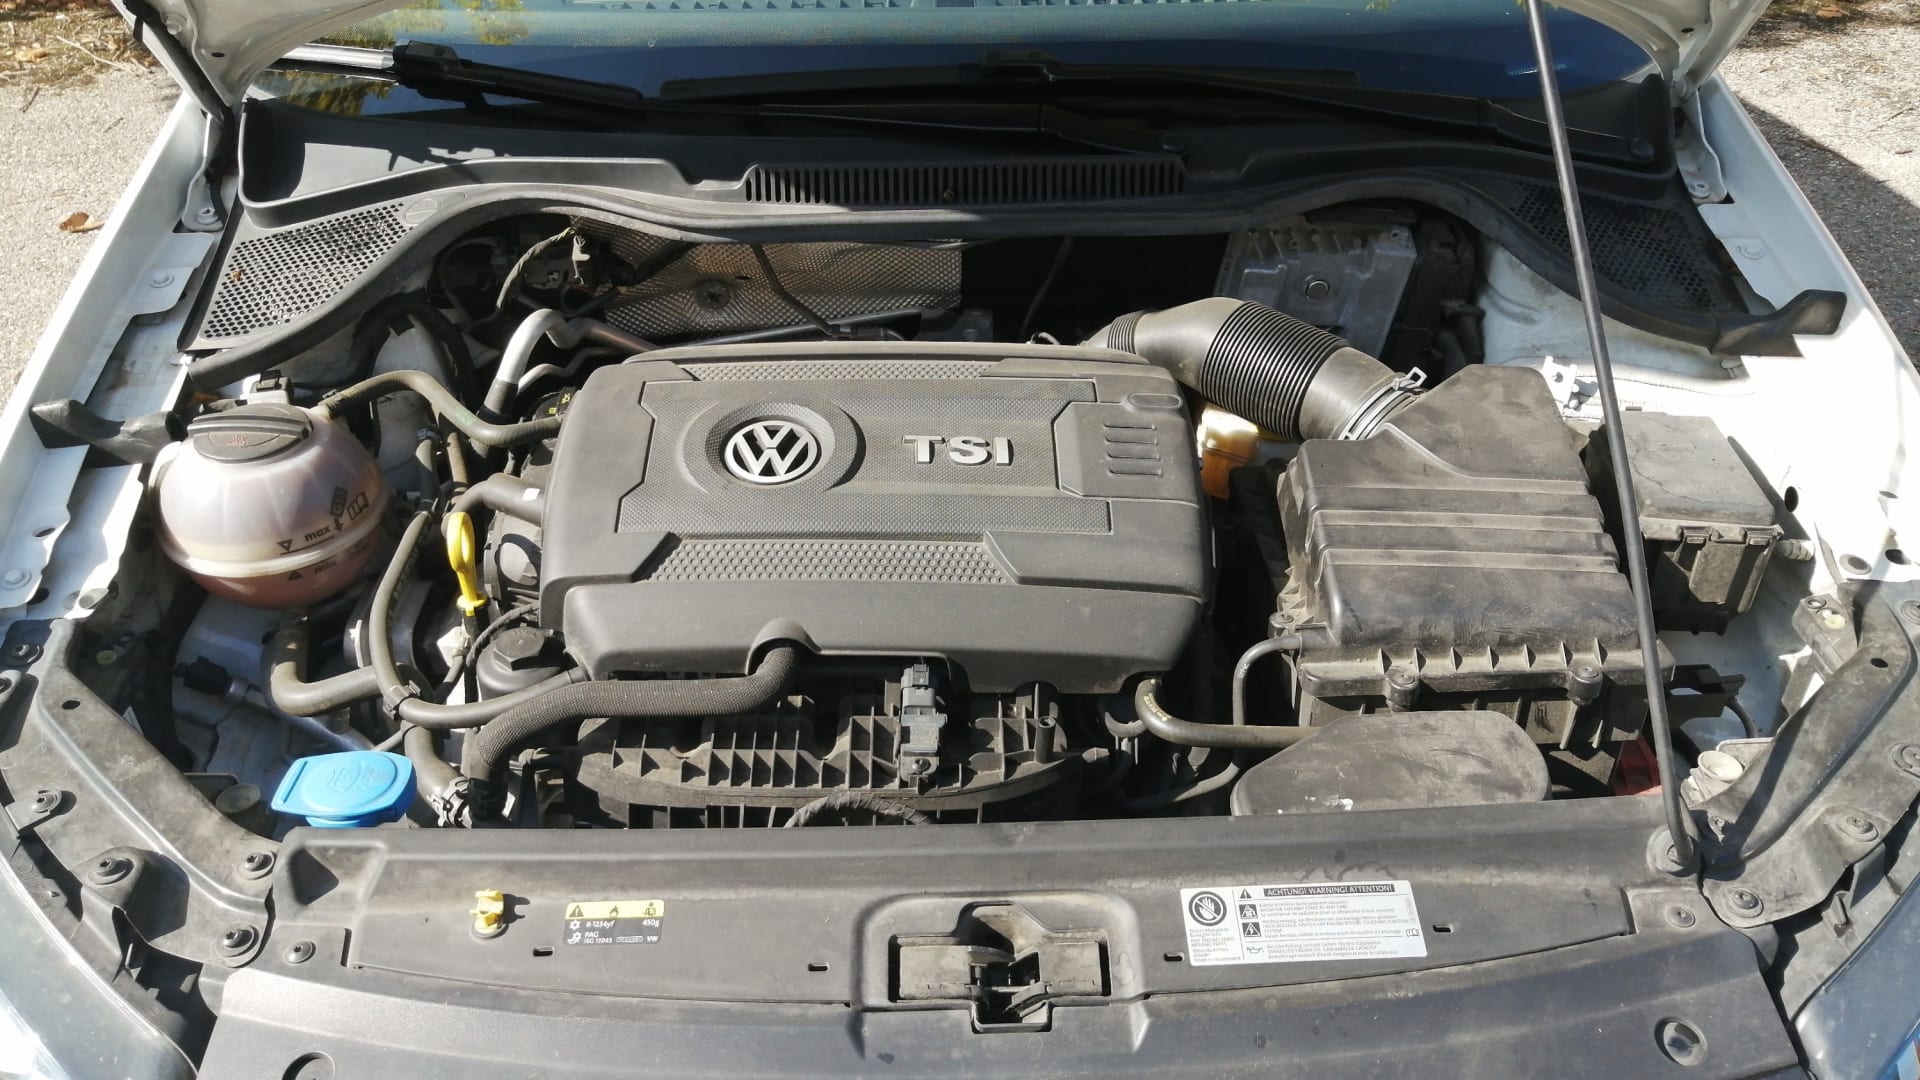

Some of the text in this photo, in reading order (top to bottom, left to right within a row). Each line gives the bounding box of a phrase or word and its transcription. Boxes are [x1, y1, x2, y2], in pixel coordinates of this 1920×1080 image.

[902, 434, 1012, 466] TSI
[304, 526, 331, 542] max
[1267, 884, 1393, 897] ACHTUNG! WARNING! ATTENTION!
[642, 919, 660, 928] 450g
